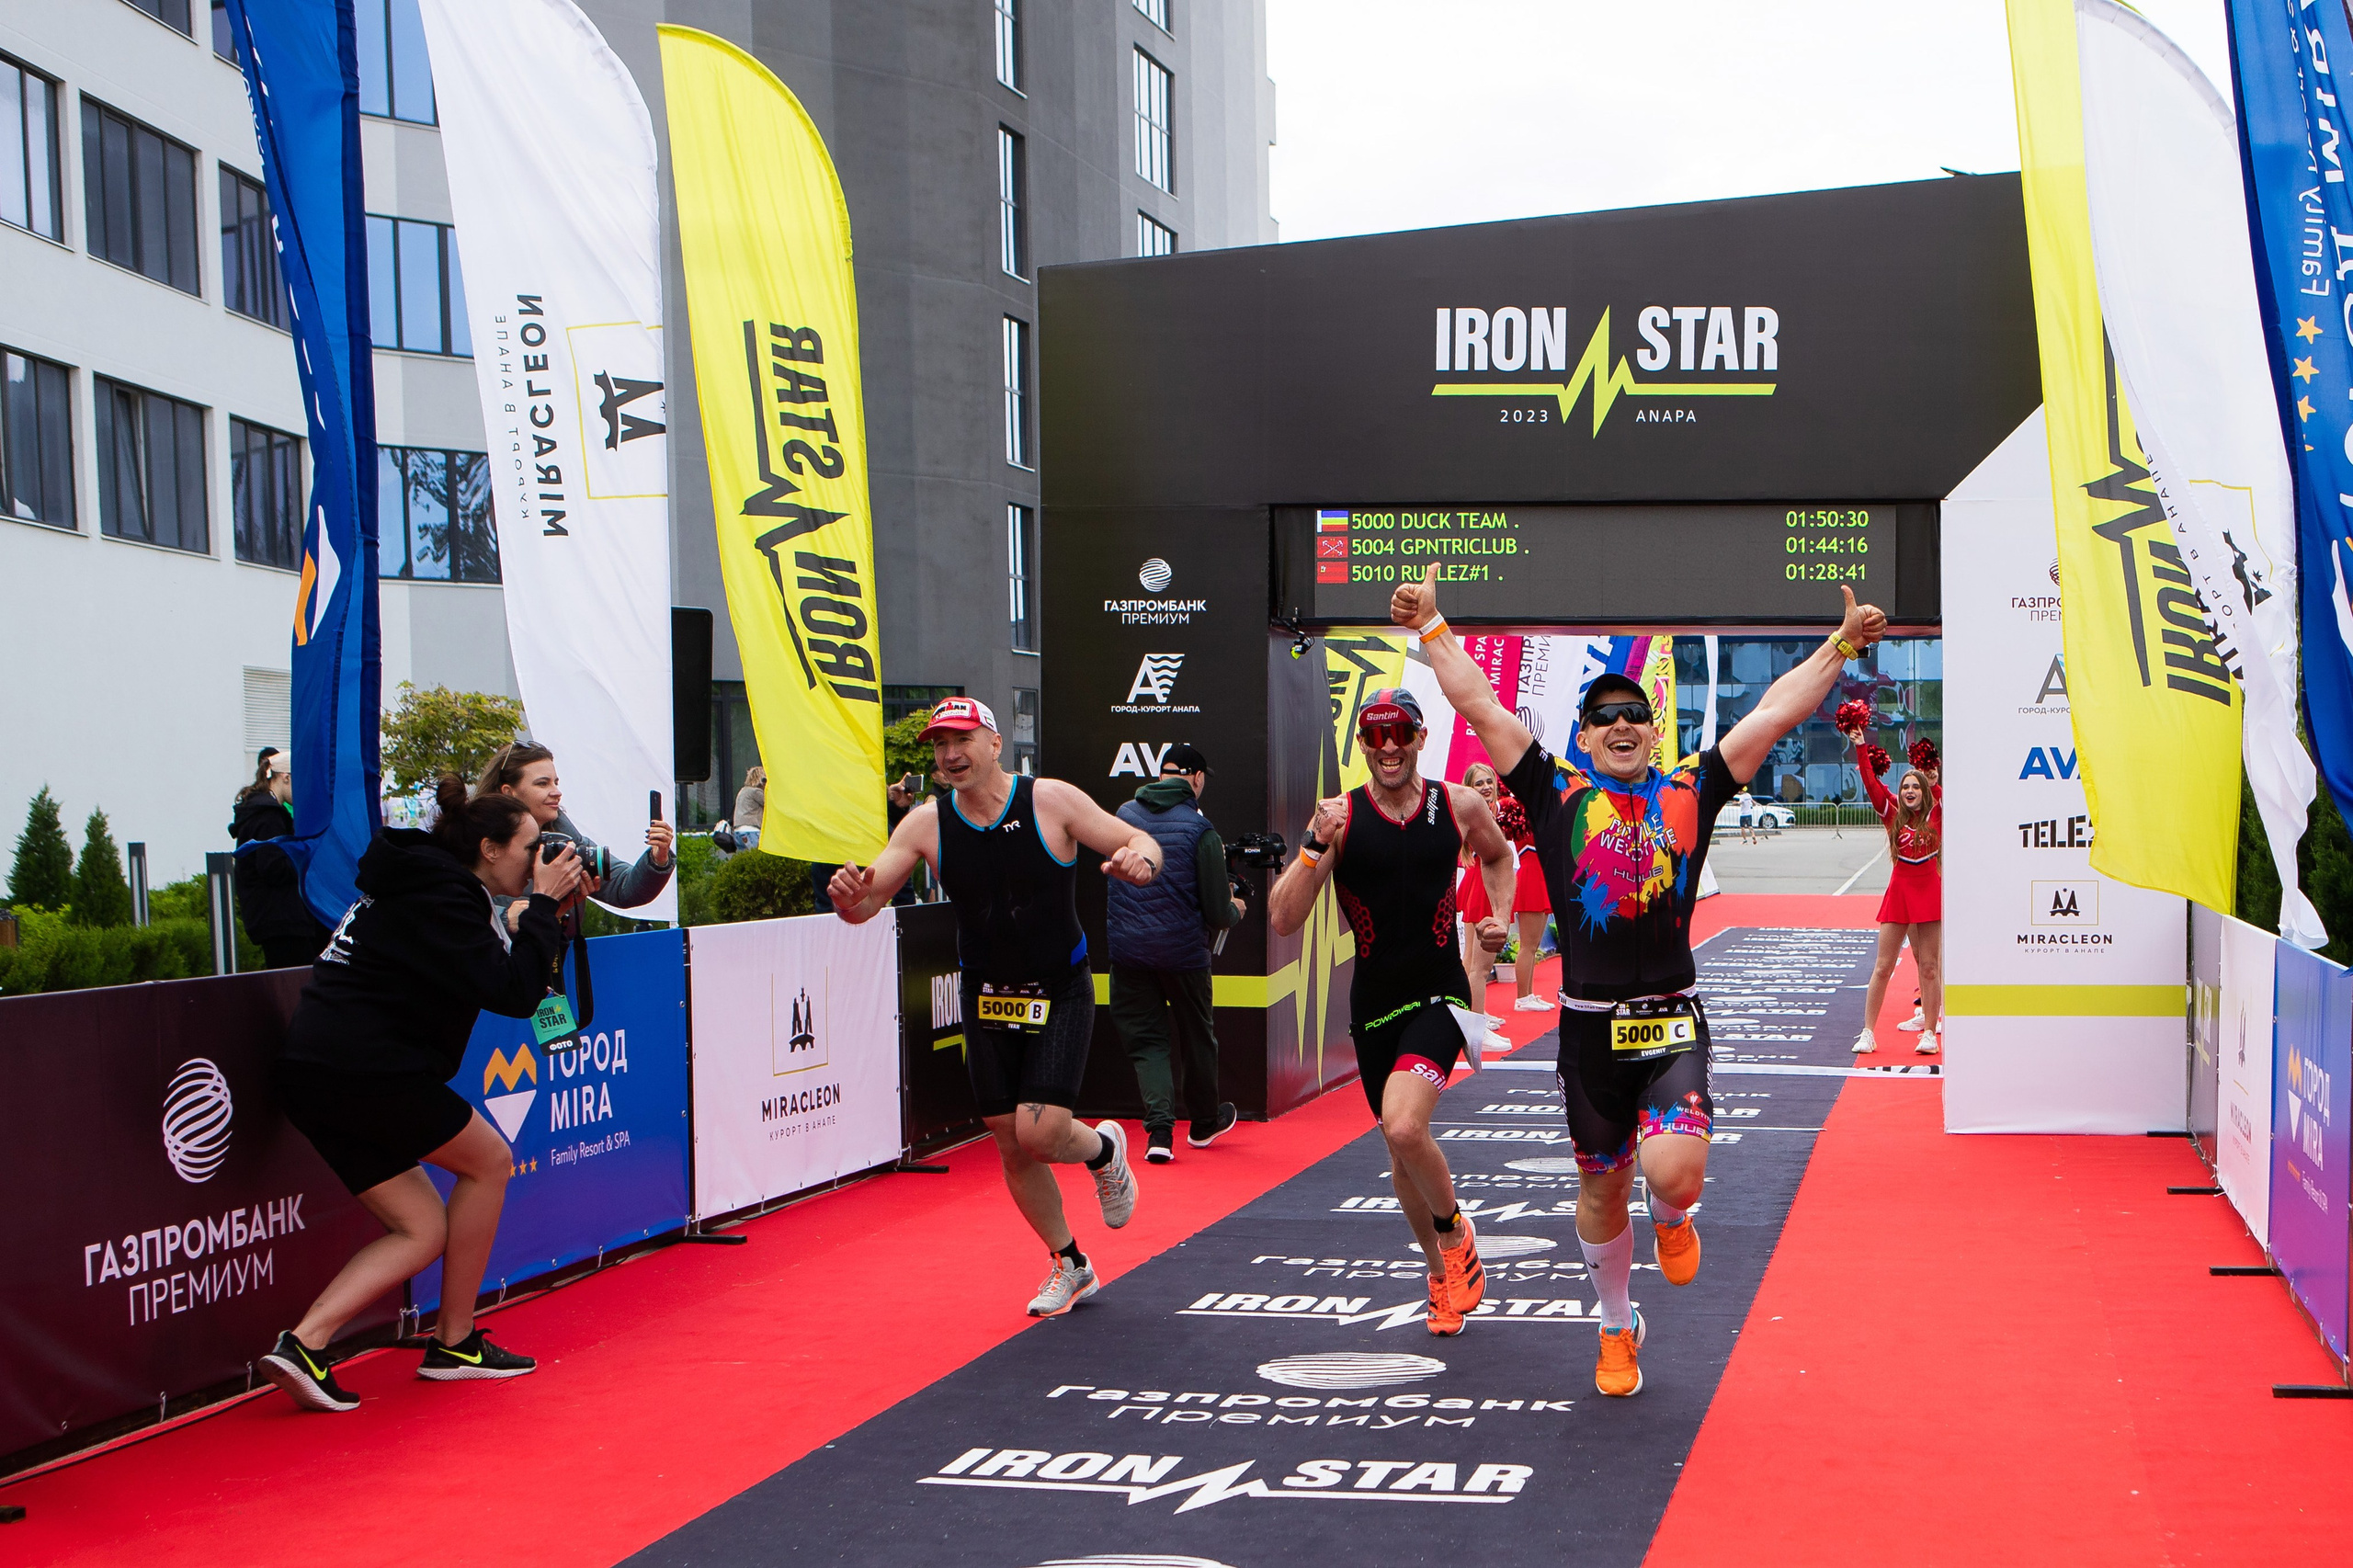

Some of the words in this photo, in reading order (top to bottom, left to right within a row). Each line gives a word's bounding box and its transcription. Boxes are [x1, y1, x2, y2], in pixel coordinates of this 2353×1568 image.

[1436, 307, 1566, 371] IRON
[1636, 306, 1779, 371] STAR
[1500, 409, 1549, 423] 2023
[1635, 409, 1697, 423] ANAPA
[1351, 513, 1395, 529] 5000
[1401, 513, 1451, 529] DUCK
[1457, 512, 1507, 529] TEAM
[1786, 510, 1870, 528] 01:50:30
[1352, 538, 1395, 555] 5004
[1400, 538, 1518, 555] GPNTRICLUB
[1785, 537, 1869, 554] 01:44:16
[1351, 564, 1395, 581] 5010
[1401, 564, 1490, 582] RULEZ#1
[1785, 563, 1867, 581] 01:28:41
[1104, 599, 1207, 612] ГАЗПРОМБАНК
[1121, 613, 1189, 624] ПРЕМИУМ
[1110, 705, 1171, 713] ГОРОД-КУРОРТ
[1367, 710, 1399, 721] Santini
[1108, 743, 1191, 777] AV
[2018, 747, 2082, 779] AV
[1427, 787, 1438, 825] sailfish
[1003, 820, 1020, 833] TYR
[2017, 935, 2113, 945] MIRACLEON
[536, 1006, 555, 1017] IRON
[982, 1000, 1026, 1017] 5000
[1032, 1004, 1042, 1019] B
[539, 1013, 567, 1029] STAR
[1617, 1024, 1665, 1044] 5000
[1674, 1023, 1686, 1039] C
[549, 1040, 574, 1051] ФОТО
[1641, 1047, 1666, 1057] EVGENIY
[551, 1082, 613, 1132] MIRA
[761, 1083, 840, 1122] MIRACLEON
[769, 1124, 801, 1142] КУРОРТ
[813, 1115, 835, 1131] АНАПЕ
[1441, 1129, 1561, 1139] IRON
[551, 1144, 578, 1166] Family
[579, 1140, 605, 1159] Resort
[606, 1134, 613, 1152] &
[614, 1131, 631, 1149] SPA
[85, 1193, 305, 1287] ГАЗПРОМБАНК
[129, 1248, 274, 1326] ПРЕМИУМ
[1186, 1292, 1371, 1313] IRON
[1046, 1385, 1576, 1413] Газпромбанк
[1107, 1405, 1476, 1429] Премиум
[936, 1448, 1185, 1484] IRON
[1281, 1460, 1534, 1494] STAR
